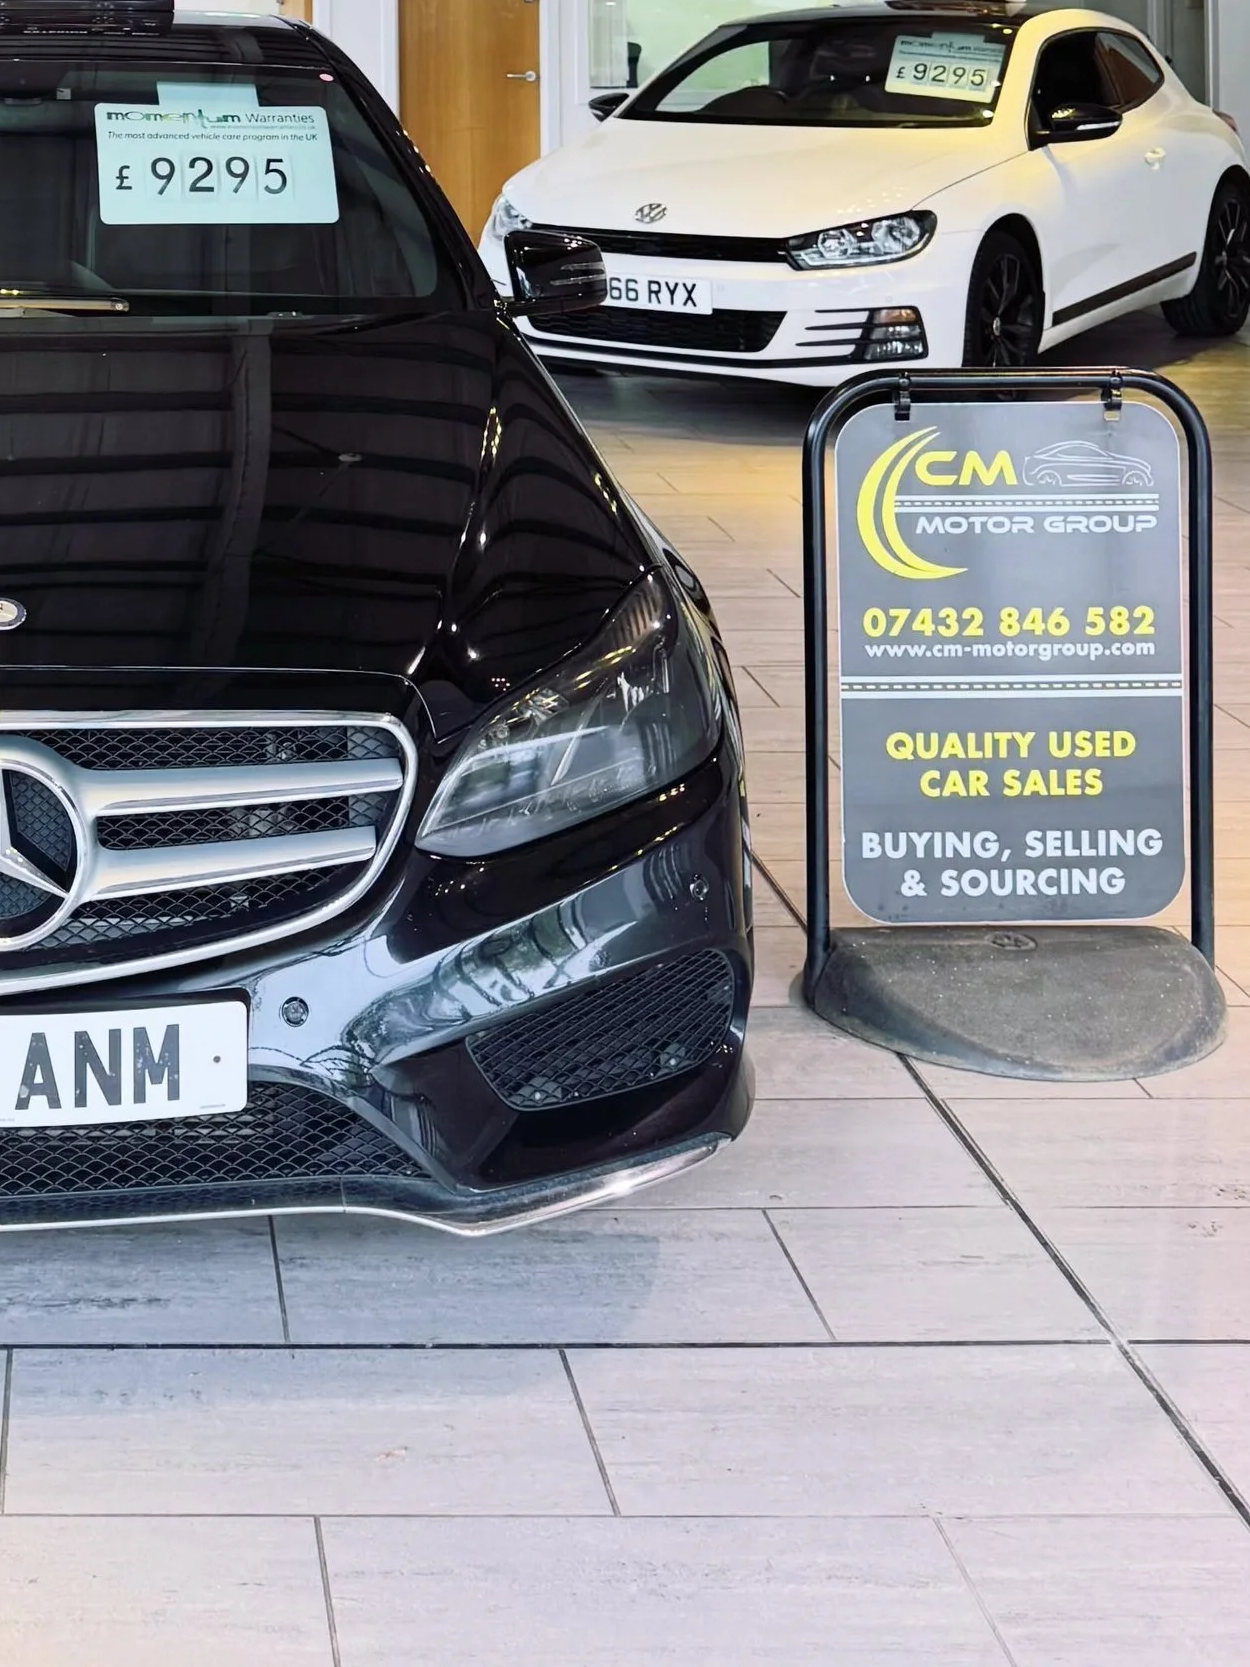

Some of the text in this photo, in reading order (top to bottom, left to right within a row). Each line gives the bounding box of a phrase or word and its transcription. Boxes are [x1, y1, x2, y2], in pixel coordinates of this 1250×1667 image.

[106, 109, 315, 129] momentum Warranties
[108, 131, 123, 139] The
[192, 132, 220, 140] vehicle
[648, 280, 697, 307] RYX
[915, 450, 1018, 486] CM
[916, 515, 1157, 534] MOTOR GROUP
[862, 605, 1155, 638] 07432 846 582
[865, 641, 1155, 662] www.cm-motorgroup.com
[885, 730, 1137, 760] QUALITY USED
[919, 768, 1104, 797] CAR SALES
[861, 828, 1163, 862] BUYING, SELLING
[900, 867, 1126, 897] & SOURCING
[14, 1024, 180, 1111] ANM
